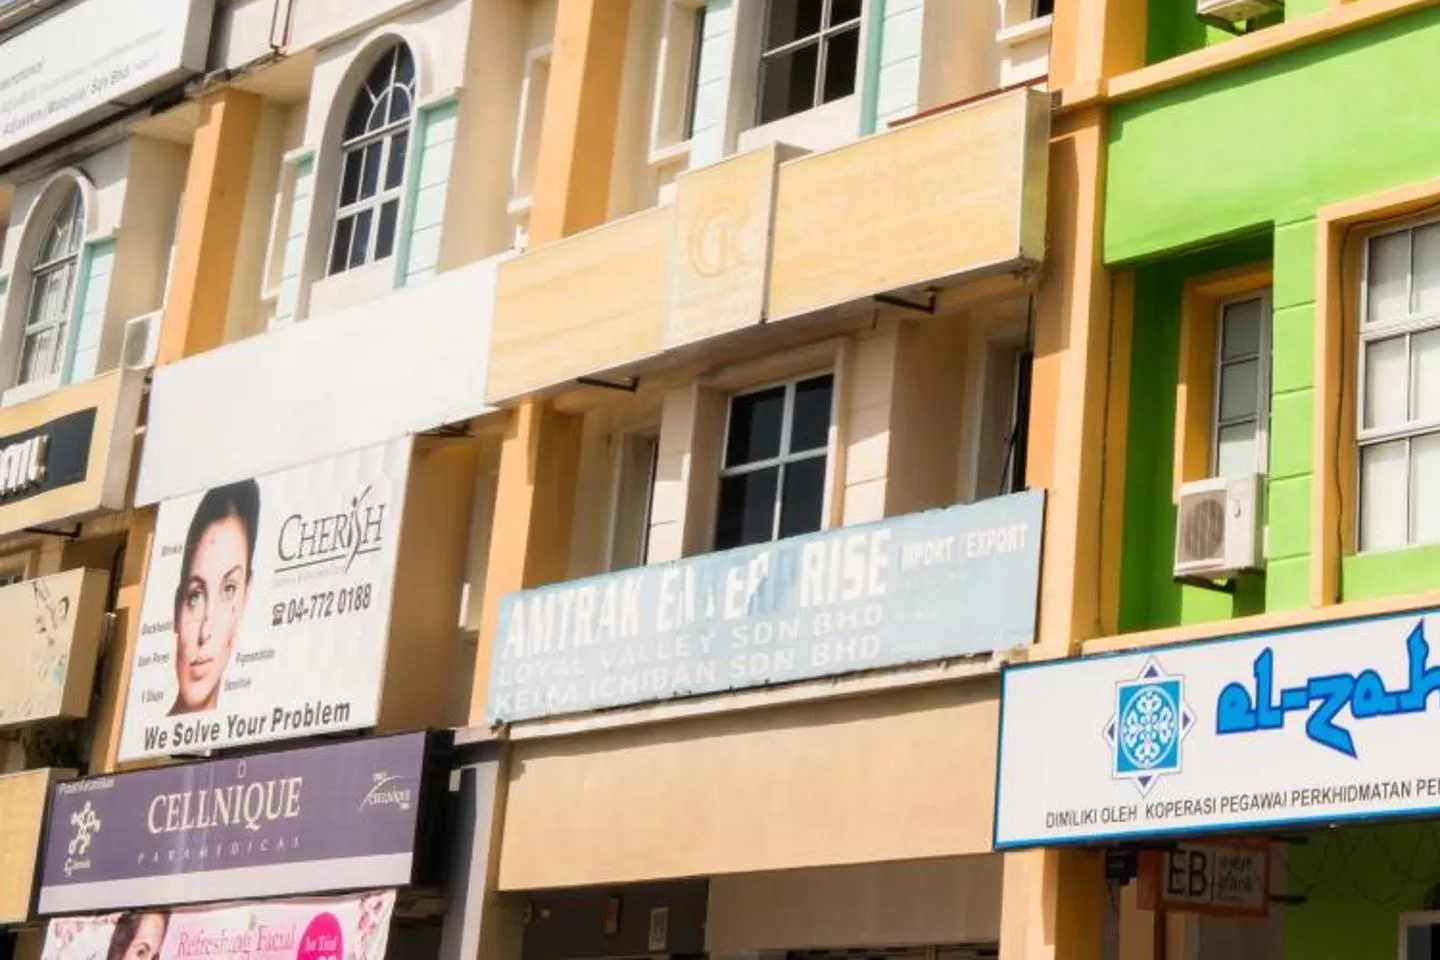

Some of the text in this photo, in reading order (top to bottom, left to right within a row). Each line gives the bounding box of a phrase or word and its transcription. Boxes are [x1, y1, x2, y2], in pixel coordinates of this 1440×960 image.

[966, 521, 1028, 559] EXPORT
[287, 584, 372, 624] 04-772 0188
[600, 632, 716, 670] VALLEY
[731, 617, 800, 649] SDN
[813, 604, 882, 638] BHD
[728, 648, 795, 681] SDN
[811, 635, 881, 668] BHD
[144, 700, 350, 751] We Solve Your Problem
[147, 776, 302, 835] CELLNIQUE
[1045, 806, 1098, 829] DIMILIKI
[1100, 805, 1138, 824] OLEH
[1145, 797, 1217, 820] KOPERASI
[1220, 793, 1287, 813] PEGAWAI
[1291, 782, 1411, 807] PERKHIDMATAN
